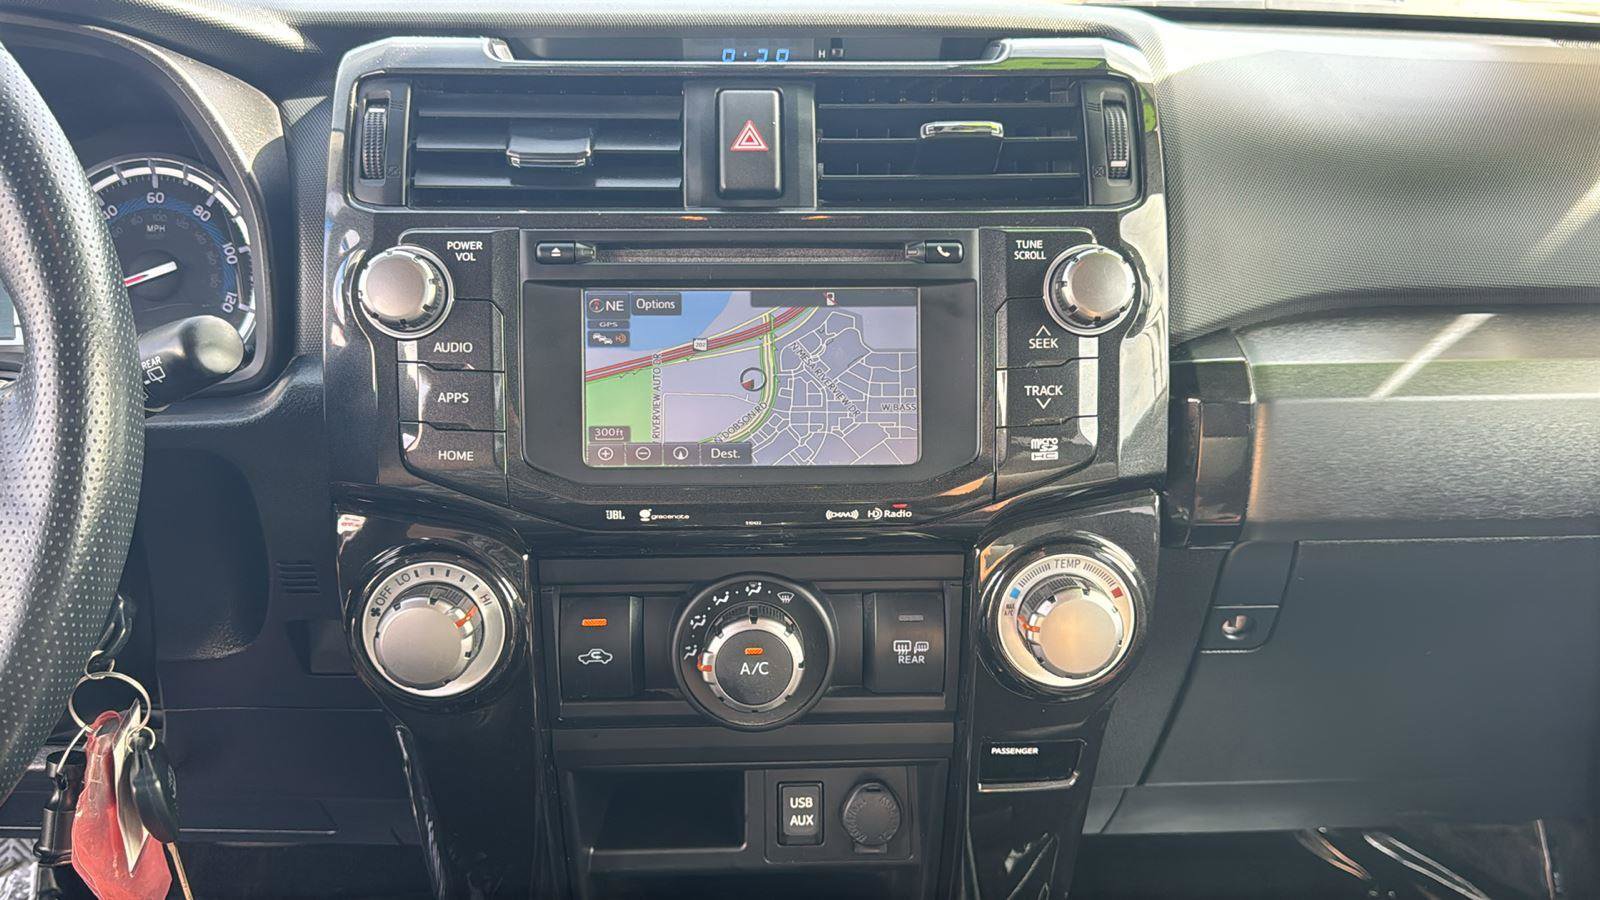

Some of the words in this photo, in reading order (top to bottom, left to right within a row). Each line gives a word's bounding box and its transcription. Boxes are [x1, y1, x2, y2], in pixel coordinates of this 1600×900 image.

[147, 192, 165, 203] 60
[192, 205, 212, 222] 80
[446, 241, 483, 250] POWER
[1015, 240, 1043, 249] TUNE
[222, 242, 239, 265] 100
[455, 252, 476, 261] VOL
[1014, 251, 1046, 260] SCROLL
[222, 291, 238, 313] 120
[605, 300, 625, 311] NE
[636, 298, 676, 311] Options
[433, 342, 473, 353] AUDIO
[1029, 338, 1058, 349] SEEK
[141, 355, 162, 370] REAR
[652, 353, 661, 364] DR
[652, 367, 661, 391] AUTO
[799, 348, 816, 369] MESA
[815, 369, 850, 406] RIVERVIEW
[848, 404, 861, 417] DR
[1024, 385, 1063, 396] TRACK
[438, 392, 469, 403] APPS
[882, 403, 891, 411] W
[893, 403, 917, 411] BASS
[652, 393, 661, 439] RIVERVIEW
[721, 409, 756, 439] DOBSON
[754, 401, 768, 414] RD
[595, 428, 624, 437] 300ft
[1031, 438, 1058, 450] micro
[438, 450, 474, 461] HOME
[710, 448, 741, 459] Dest.
[605, 509, 625, 520] JBL
[867, 507, 883, 520] HD
[884, 509, 913, 518] Radio
[1054, 558, 1082, 569] TEMP
[395, 573, 411, 586] LO
[376, 585, 393, 607] OFF
[480, 593, 493, 606] HI
[898, 655, 925, 665] REAR
[739, 661, 769, 675] A/C
[991, 747, 1039, 755] PASSENGER
[790, 797, 813, 808] USB
[790, 814, 814, 826] AUX
